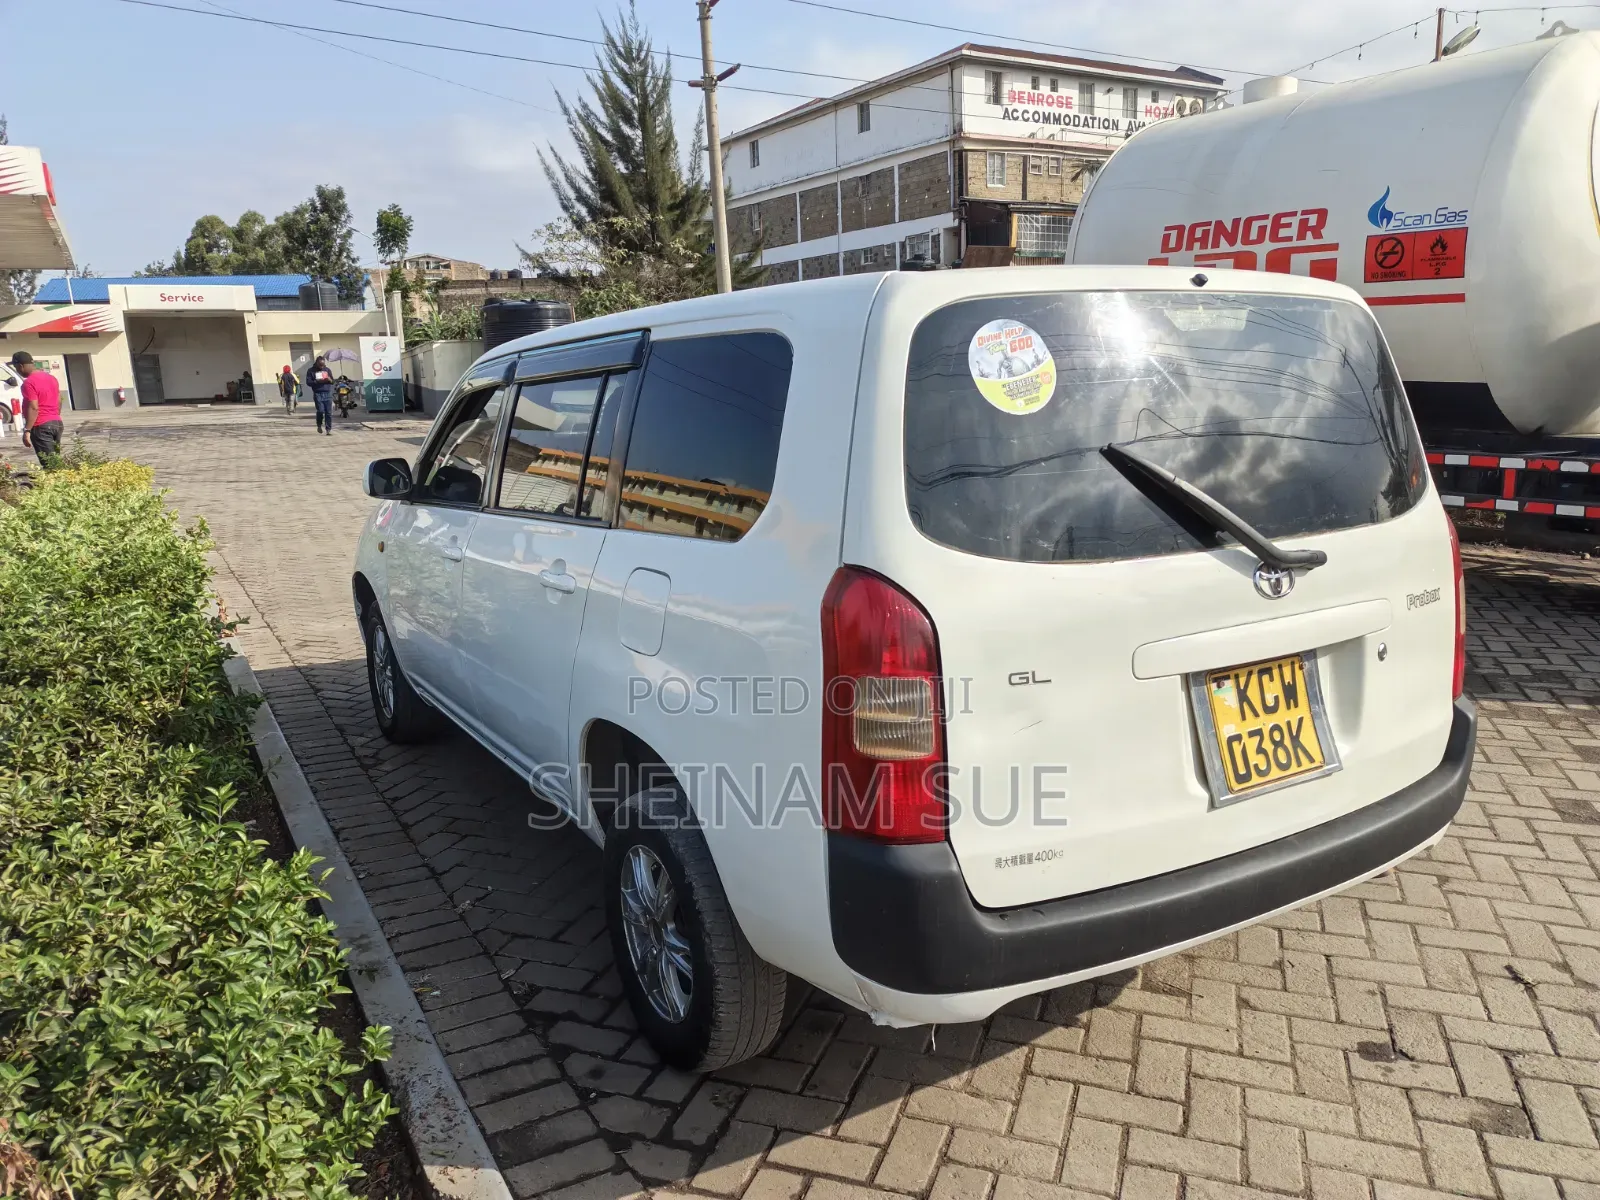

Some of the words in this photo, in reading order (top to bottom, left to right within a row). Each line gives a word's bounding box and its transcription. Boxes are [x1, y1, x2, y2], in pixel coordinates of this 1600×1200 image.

[1008, 89, 1074, 109] BENROSE
[1002, 107, 1119, 131] ACCOMMODATION
[1393, 211, 1431, 228] Scan
[1435, 207, 1468, 224] Gas
[1161, 208, 1329, 253] DANGER
[1380, 270, 1407, 279] SMOKING
[1434, 267, 1441, 275] 2
[160, 292, 204, 303] Service
[1004, 327, 1023, 338] HELP
[1009, 336, 1033, 353] GOD
[371, 386, 391, 395] light
[1008, 670, 1052, 686] GL
[1233, 660, 1299, 721] KCW
[1226, 716, 1316, 785] 038K
